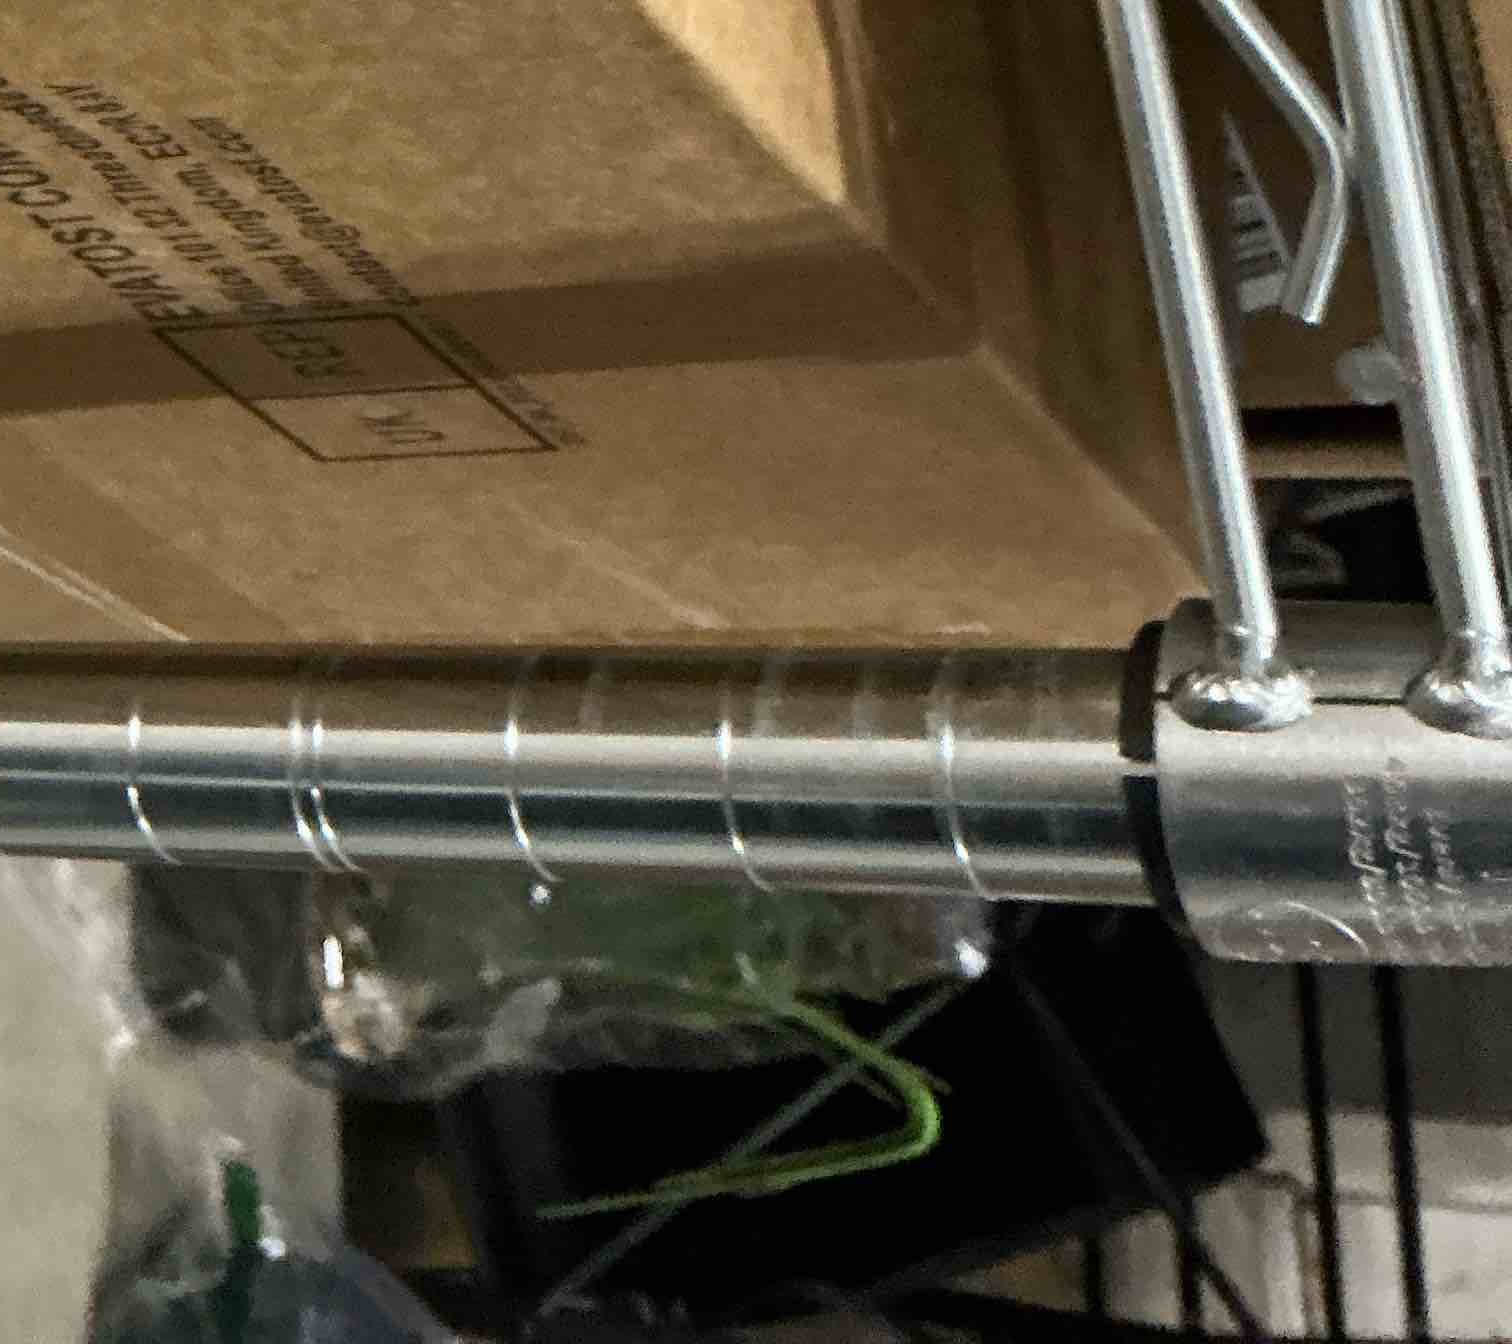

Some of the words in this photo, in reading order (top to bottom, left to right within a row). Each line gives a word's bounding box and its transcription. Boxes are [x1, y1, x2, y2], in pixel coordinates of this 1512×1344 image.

[30, 214, 214, 326] EVATOST
[255, 327, 366, 380] REP
[358, 411, 446, 445] UK
